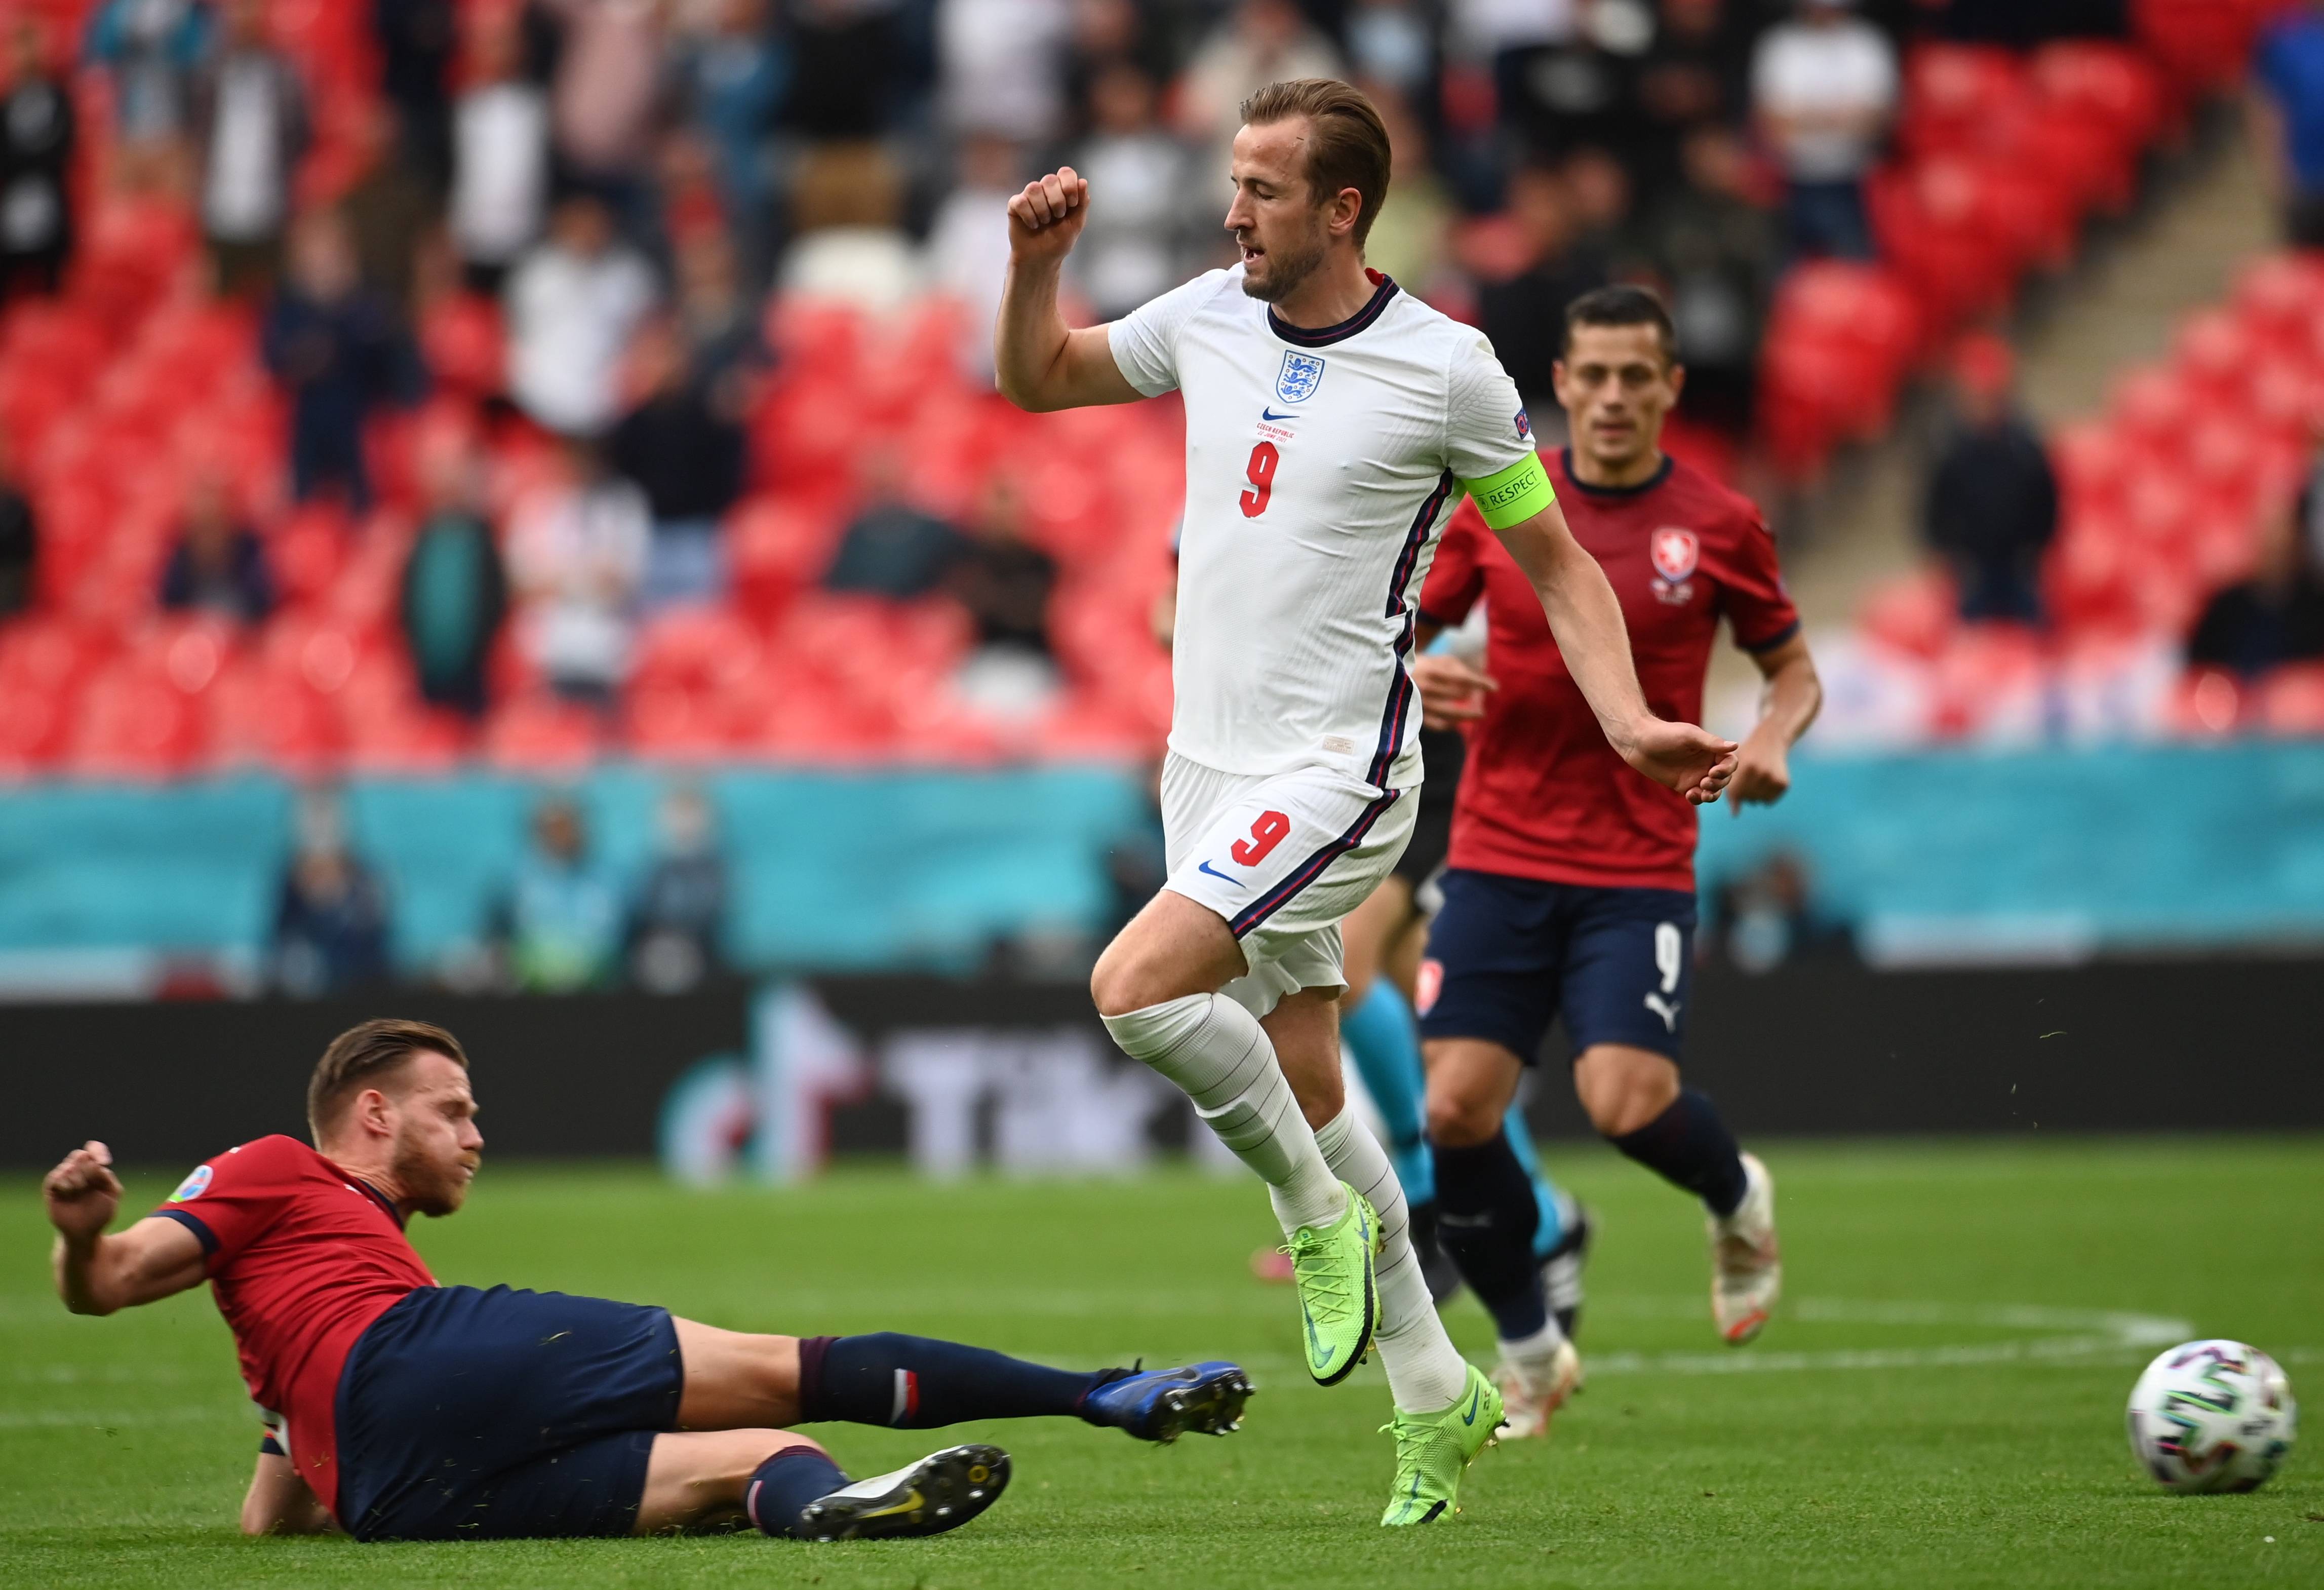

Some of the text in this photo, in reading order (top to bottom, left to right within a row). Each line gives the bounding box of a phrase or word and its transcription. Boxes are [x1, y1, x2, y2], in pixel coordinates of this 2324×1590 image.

[1256, 422, 1294, 438] CZECH REPUBLIC
[1239, 441, 1279, 518] 9
[1489, 470, 1538, 506] RESPECT
[1231, 810, 1290, 867] 9
[1655, 921, 1682, 993] 9
